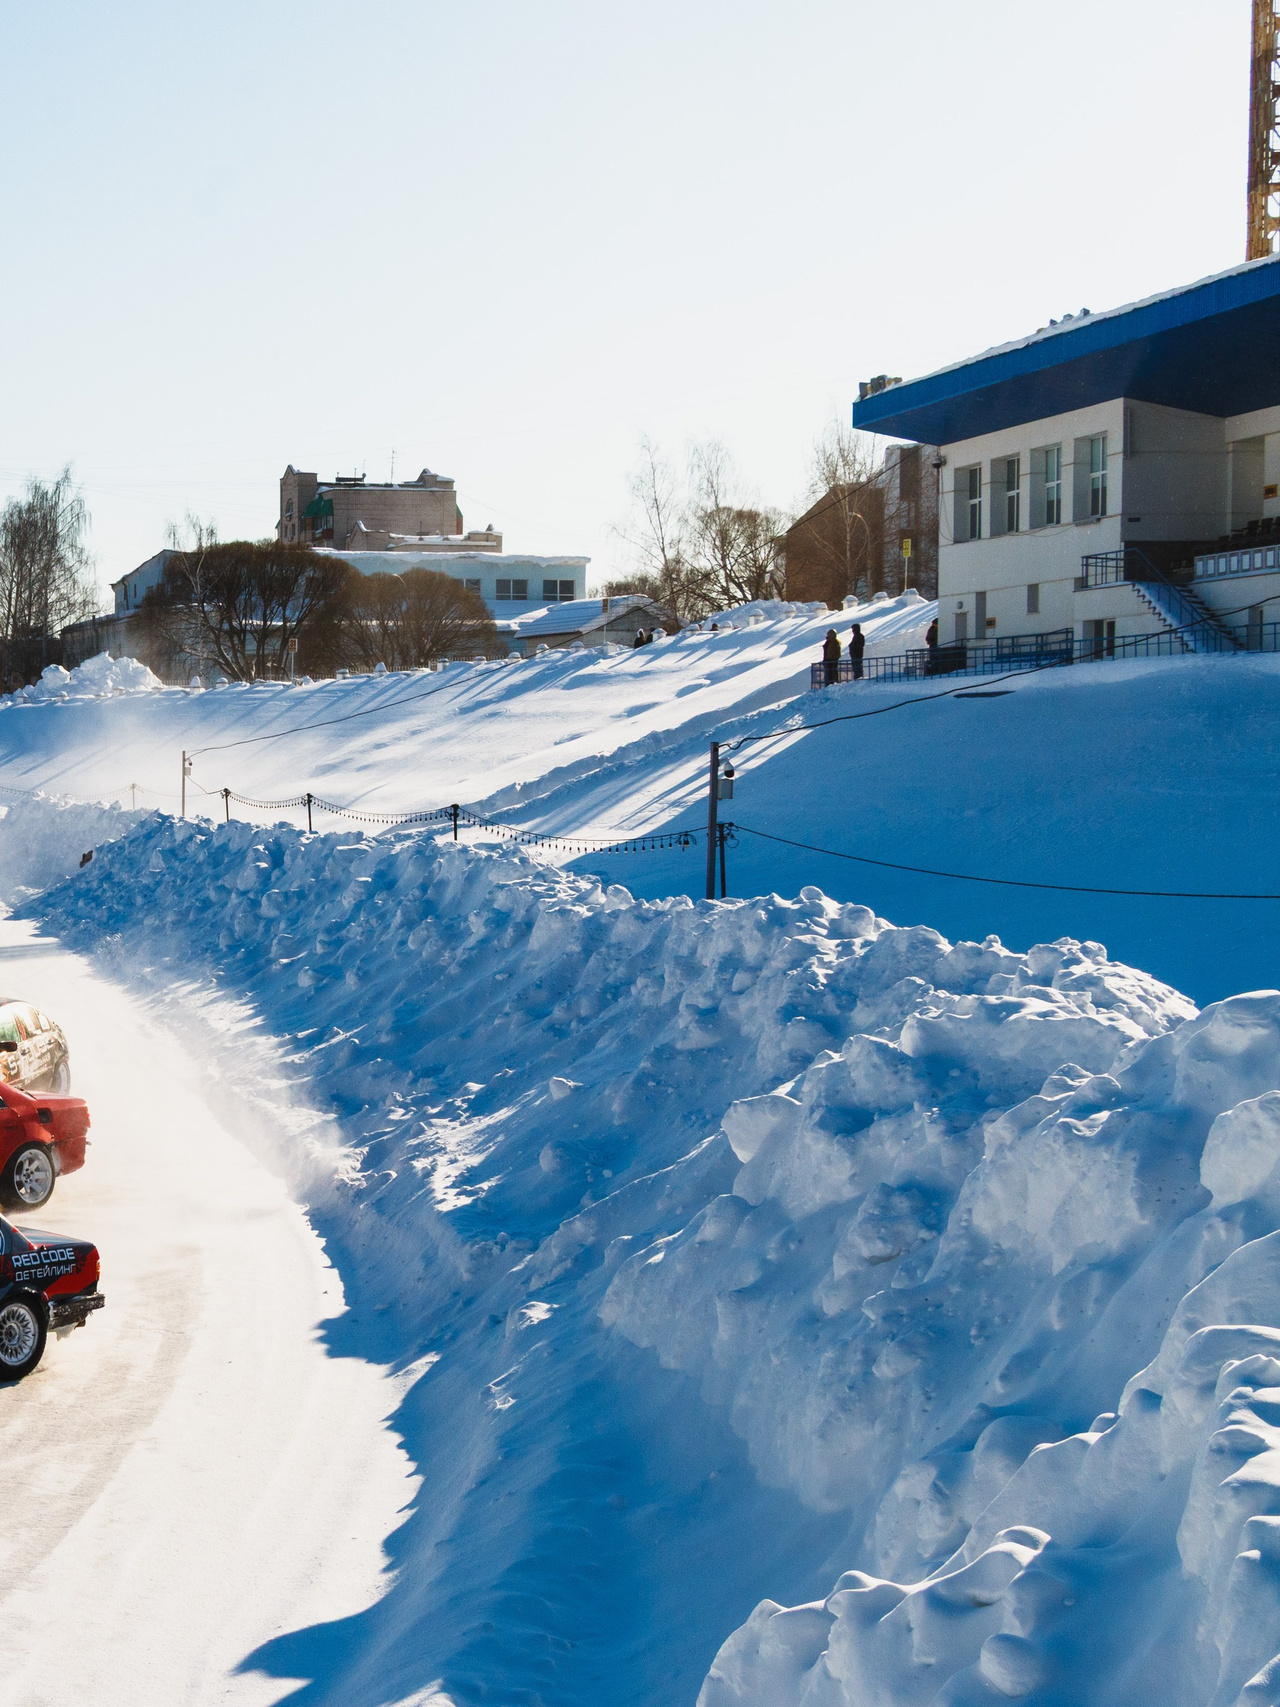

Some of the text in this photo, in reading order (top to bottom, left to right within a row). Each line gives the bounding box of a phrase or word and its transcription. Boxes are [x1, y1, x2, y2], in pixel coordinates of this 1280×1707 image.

[12, 1248, 75, 1267] RED CODE
[15, 1264, 76, 1281] ДЕТЕЙЛИНГ
